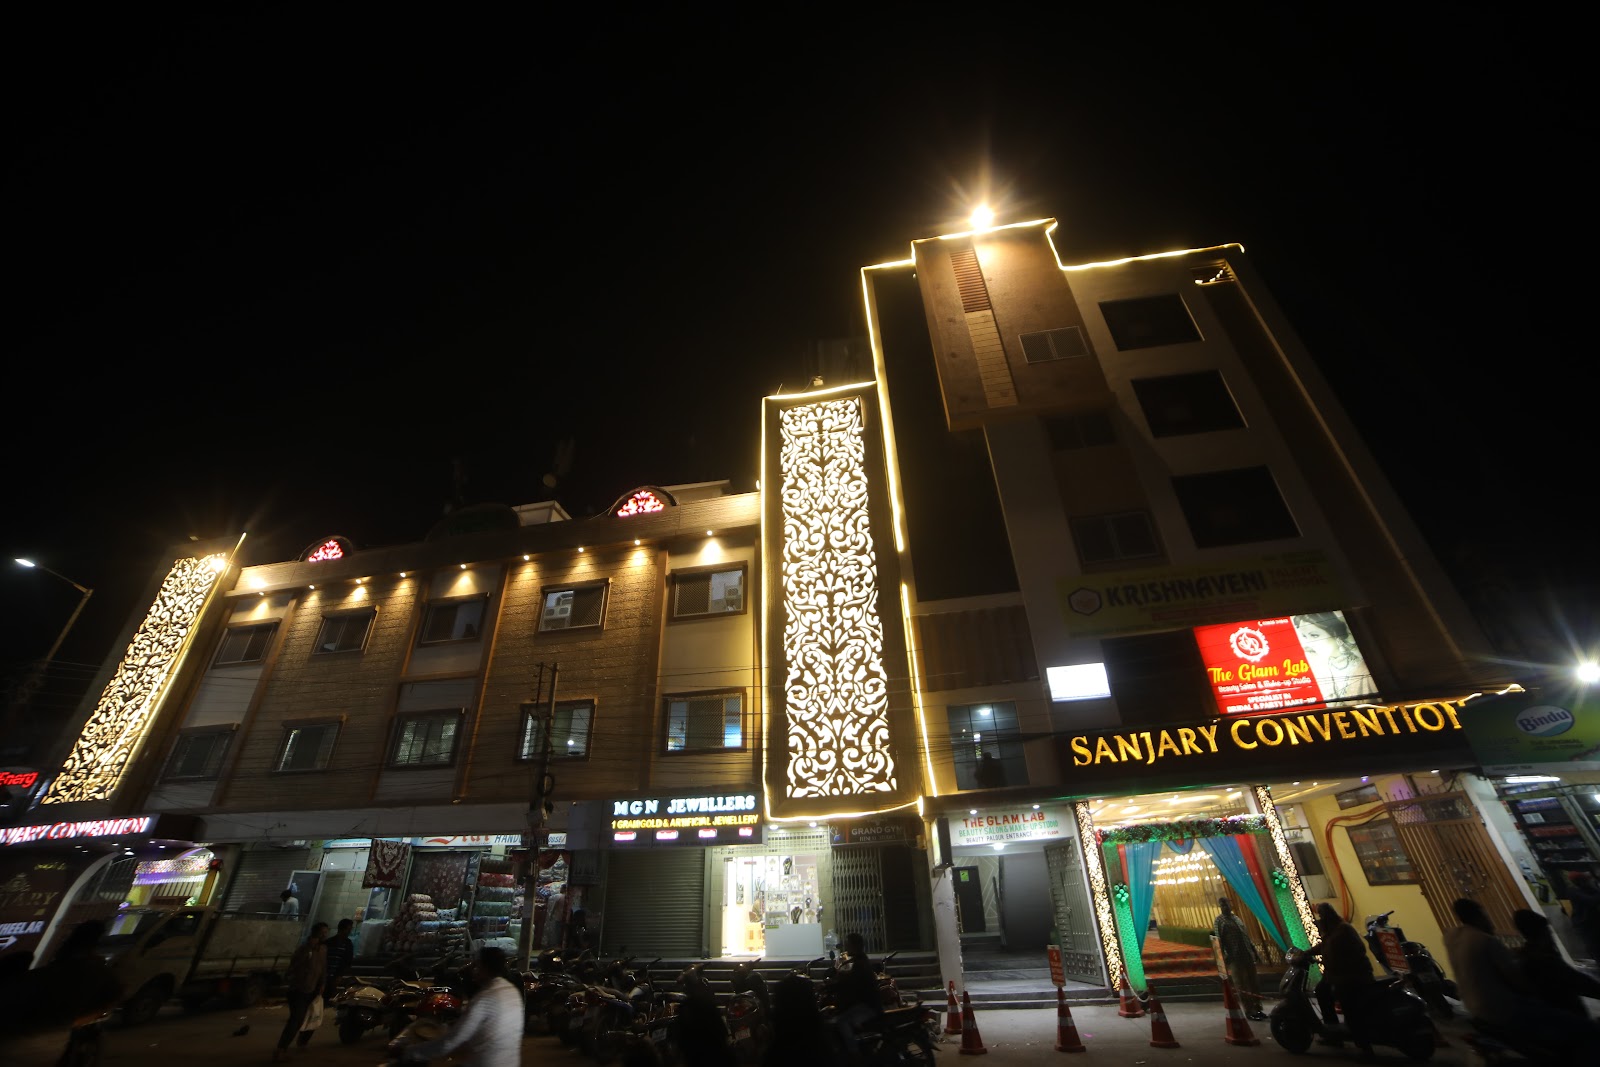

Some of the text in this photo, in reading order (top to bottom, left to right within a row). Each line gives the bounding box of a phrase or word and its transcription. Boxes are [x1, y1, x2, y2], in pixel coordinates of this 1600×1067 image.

[1105, 570, 1268, 606] KRISHNAVENI
[1207, 659, 1309, 683] The Glam Lab
[1247, 693, 1282, 704] SPECIALIST
[1227, 703, 1253, 713] BRIDAL
[1260, 700, 1284, 710] PARTY
[1518, 710, 1570, 732] Bindu
[1070, 723, 1219, 766] SANJARY
[667, 794, 756, 815] JEWELLERS
[641, 817, 663, 829] GOLD
[670, 815, 711, 828] ARTIFICIAL
[712, 814, 759, 826] JEWELLERY
[963, 811, 1046, 828] THE GLAM LAB
[851, 826, 882, 836] GRAND
[959, 828, 982, 838] BEAUTY
[985, 825, 1004, 835] SALON
[966, 836, 984, 844] BEAUTY
[1006, 831, 1033, 840] ENTRANCE
[0, 921, 45, 936] HEELAR
